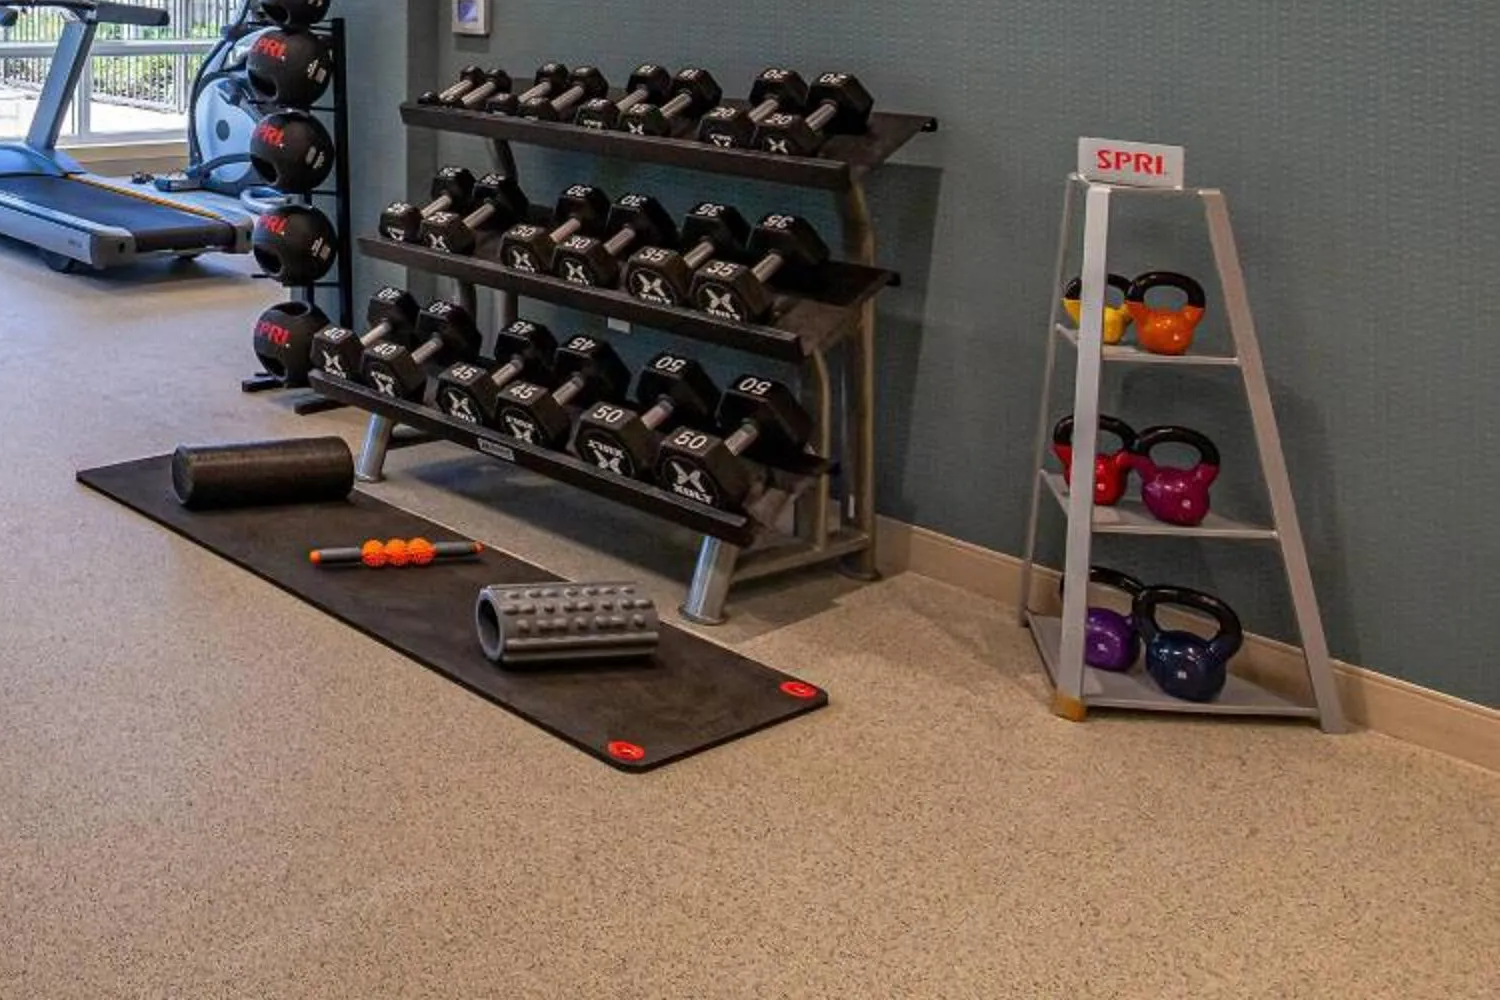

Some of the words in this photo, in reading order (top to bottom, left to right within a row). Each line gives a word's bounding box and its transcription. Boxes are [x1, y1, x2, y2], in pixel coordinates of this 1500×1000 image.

[763, 112, 793, 125] 20
[1096, 149, 1165, 175] SPRI
[695, 202, 725, 217] 35
[763, 214, 795, 229] 35
[565, 235, 592, 249] 30
[639, 247, 669, 262] 35
[706, 261, 740, 277] 35
[568, 336, 597, 351] 45
[655, 355, 686, 374] 50
[509, 383, 539, 399] 45
[738, 377, 773, 396] 50
[591, 405, 624, 423] 50
[673, 431, 708, 450] 50
